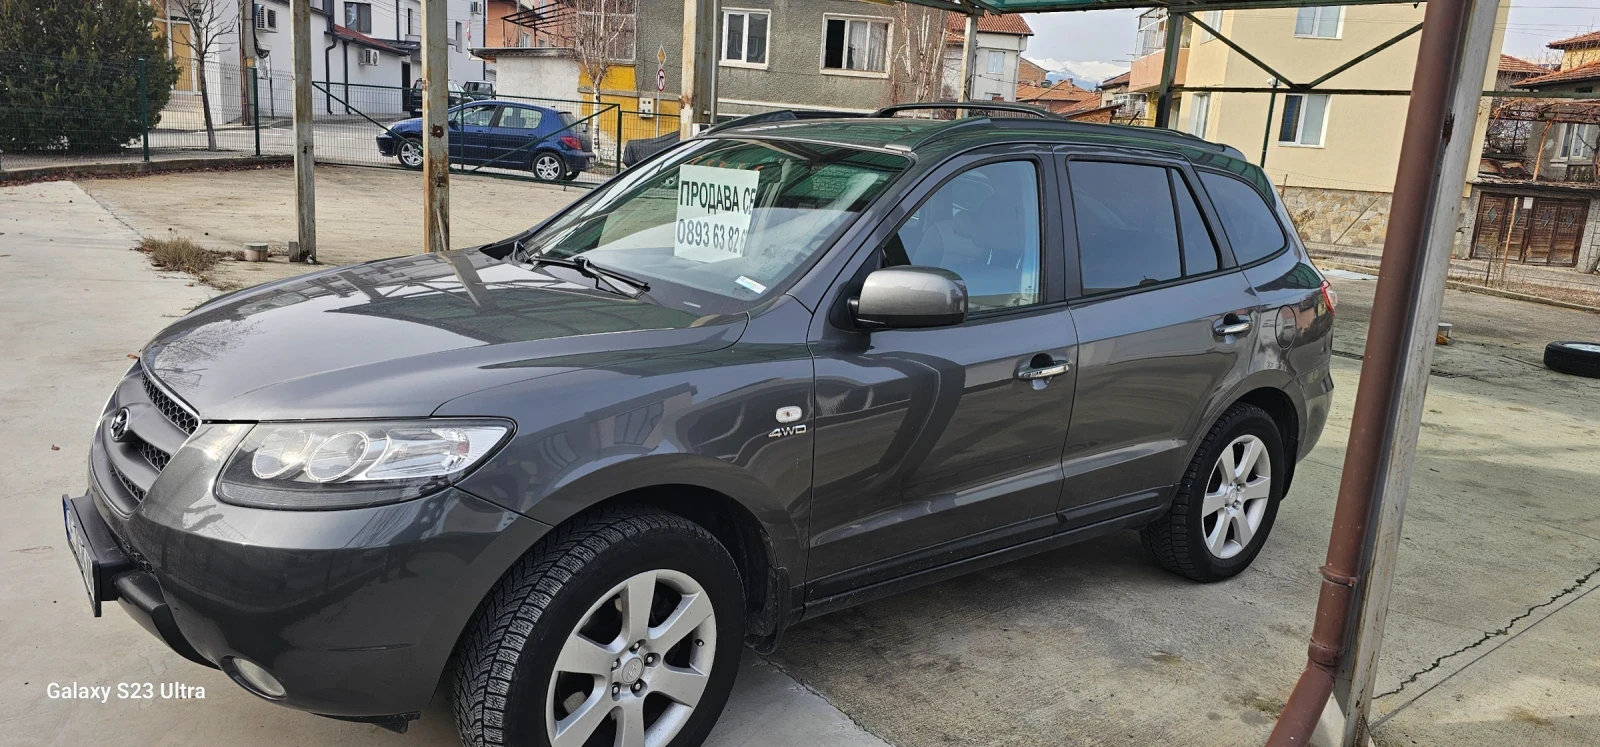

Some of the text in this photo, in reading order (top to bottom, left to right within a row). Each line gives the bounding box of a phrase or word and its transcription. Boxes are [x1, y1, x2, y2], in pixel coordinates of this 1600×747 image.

[679, 180, 739, 215] ПРОДАВА
[677, 218, 710, 247] 0893
[713, 223, 725, 250] 63
[727, 226, 740, 253] 82
[768, 424, 807, 438] 4WD
